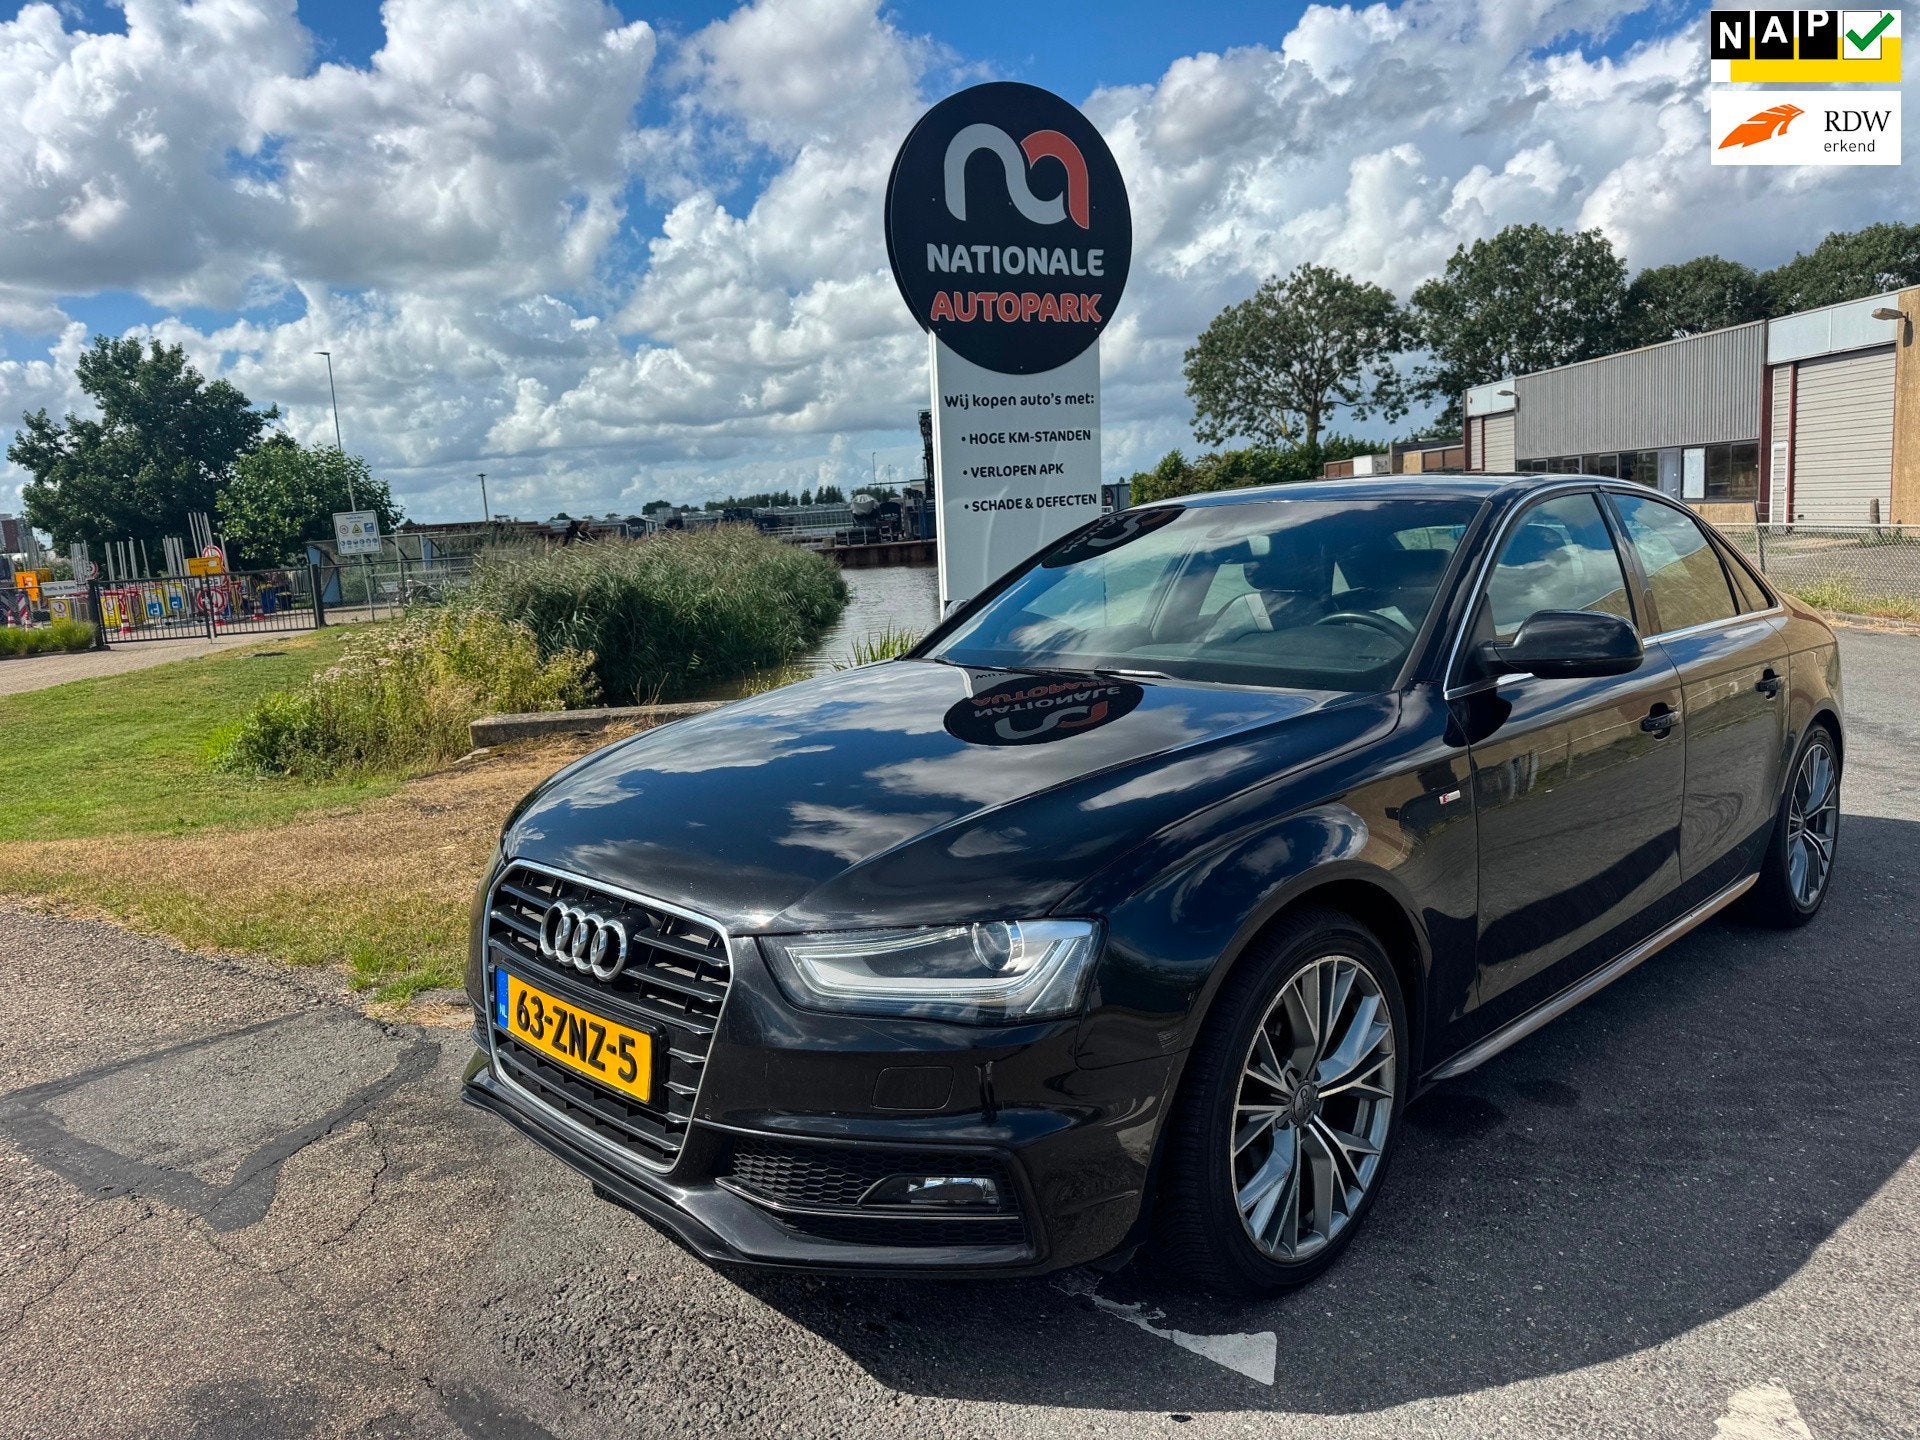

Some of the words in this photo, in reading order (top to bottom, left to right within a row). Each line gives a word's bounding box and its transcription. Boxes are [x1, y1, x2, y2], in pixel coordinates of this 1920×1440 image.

[927, 243, 1104, 277] NATIONALE
[930, 290, 1102, 323] AUTOPARK
[944, 395, 969, 411] Wij
[972, 394, 1017, 410] kopen
[1020, 392, 1062, 406] auto's
[1065, 392, 1095, 405] met:
[969, 432, 1006, 445] HOGE
[1008, 429, 1091, 444] KM-STANDEN
[971, 464, 1037, 478] VERLOPEN
[1039, 463, 1064, 475] APK
[972, 498, 1023, 512] SCHADE
[1025, 499, 1034, 509] &
[1036, 493, 1097, 508] DEFECTEN
[516, 989, 638, 1083] 63-ZNZ-5
